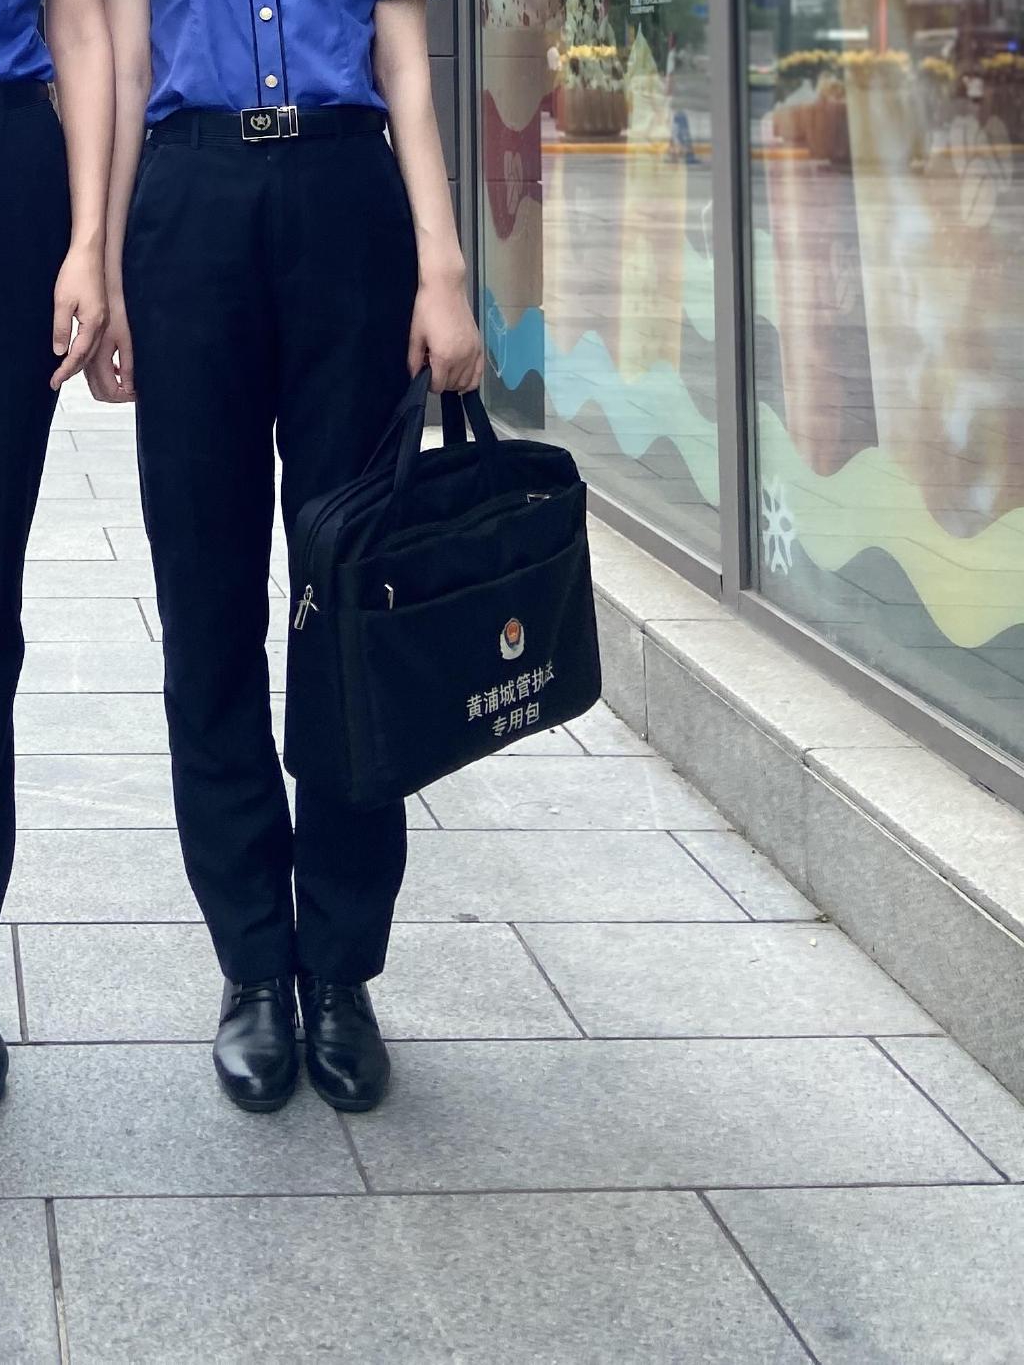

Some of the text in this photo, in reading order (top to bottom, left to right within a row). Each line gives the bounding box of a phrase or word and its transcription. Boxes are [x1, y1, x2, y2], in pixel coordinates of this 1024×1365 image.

[466, 658, 555, 722] 黄浦城管执法
[491, 701, 540, 737] 专用包
